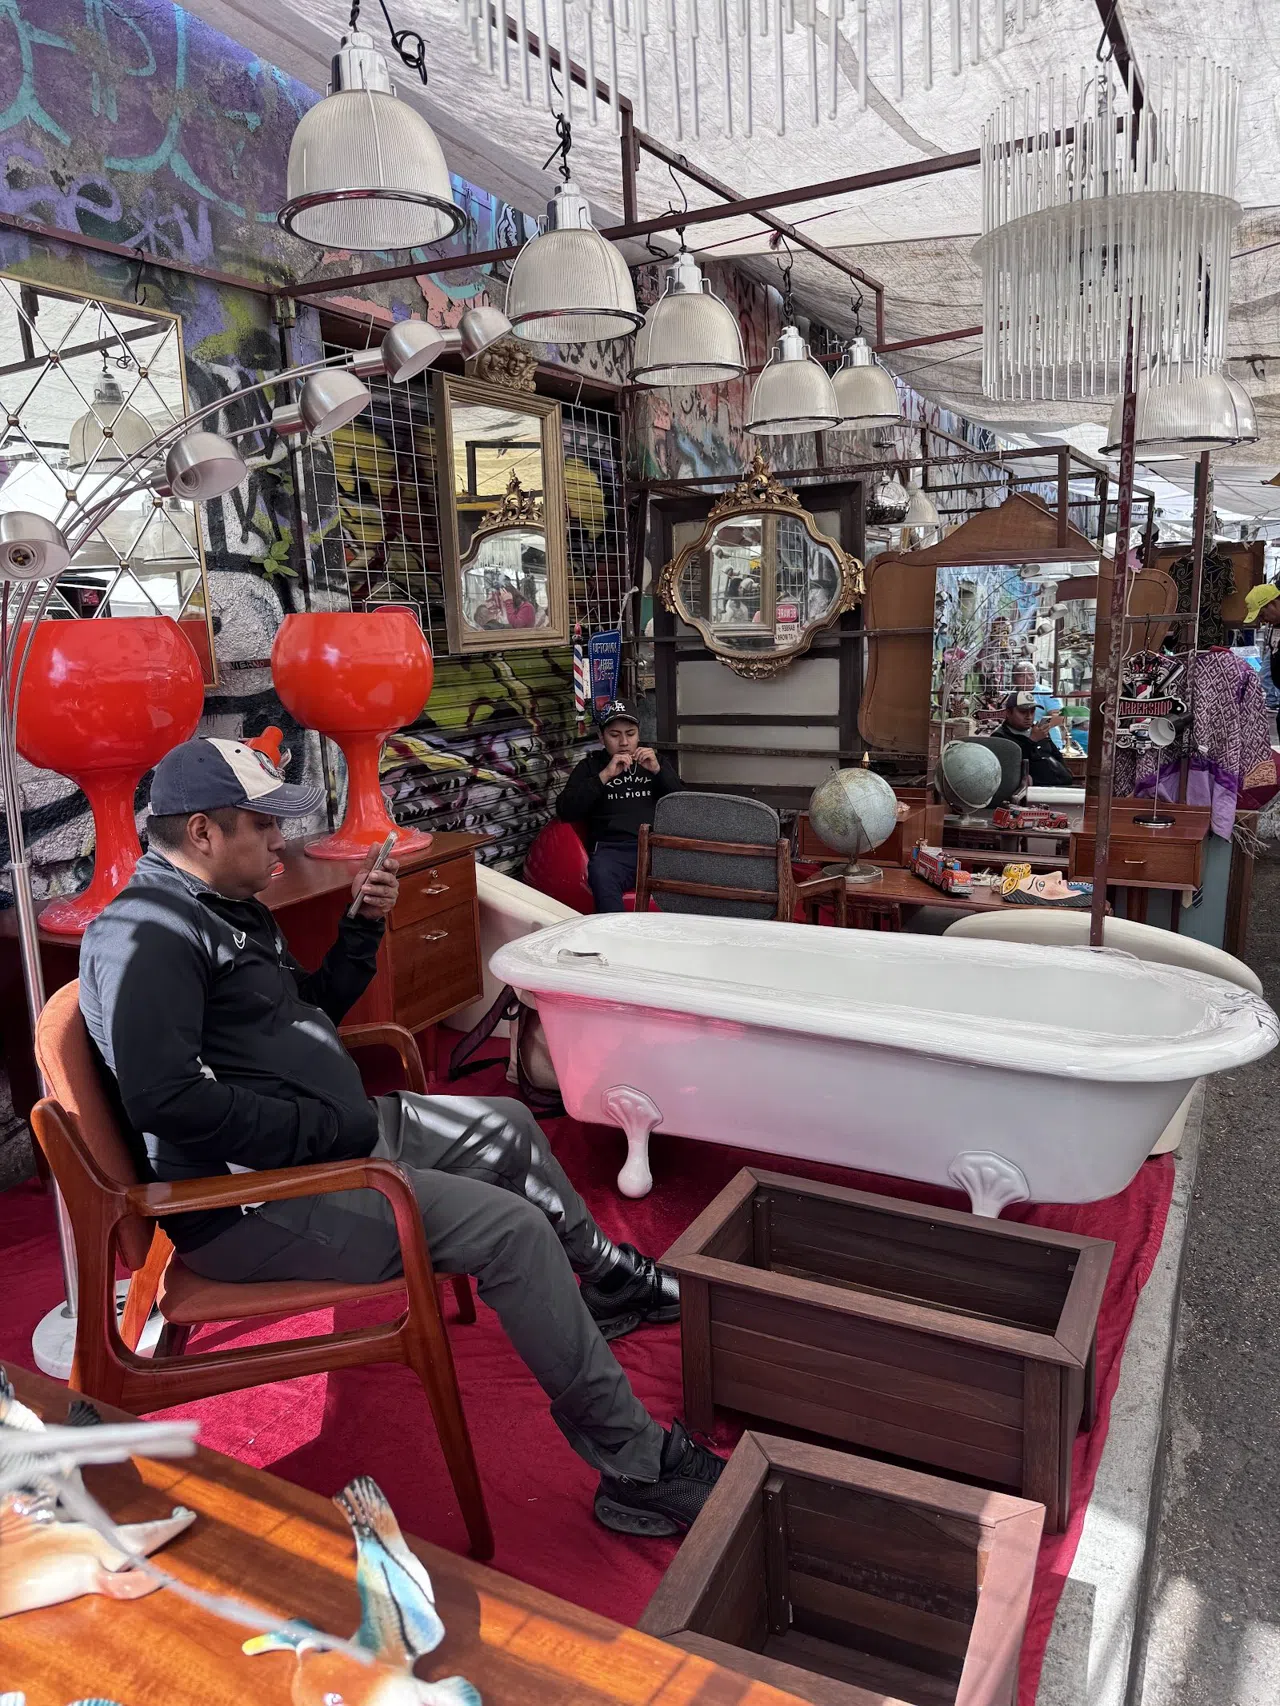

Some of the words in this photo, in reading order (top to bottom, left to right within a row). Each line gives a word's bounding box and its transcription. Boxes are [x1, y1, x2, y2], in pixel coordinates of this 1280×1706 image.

[613, 699, 626, 712] LA
[1119, 700, 1173, 716] ARBERSHOP
[606, 775, 652, 788] TOMMY
